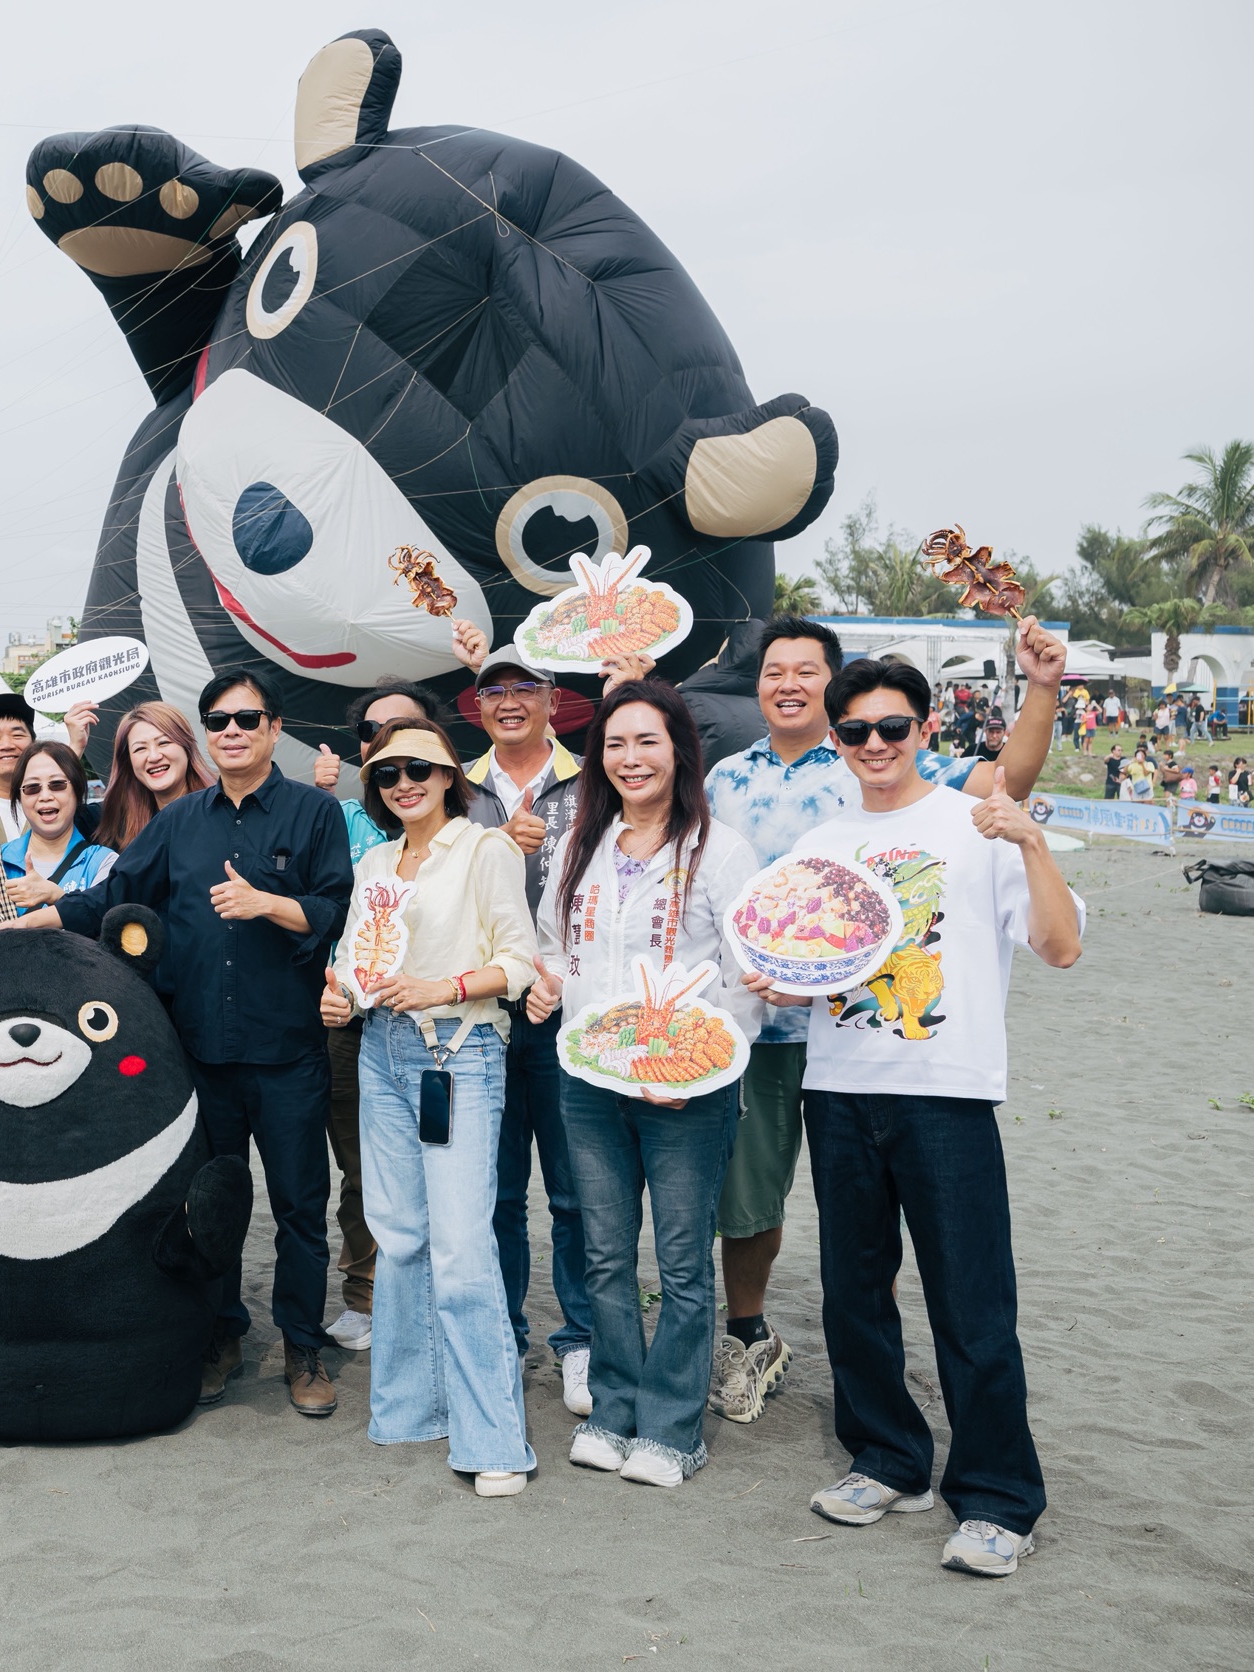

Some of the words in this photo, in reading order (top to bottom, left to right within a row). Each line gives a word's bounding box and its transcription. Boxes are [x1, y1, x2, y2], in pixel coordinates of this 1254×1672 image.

[31, 646, 140, 695] 高雄市政府觀光局
[32, 687, 65, 703] TOURISM
[66, 676, 96, 692] BUREAU
[98, 661, 141, 680] KAOHSIUNG
[584, 883, 601, 941] 哈瑪星商圈
[649, 897, 668, 949] 總會長
